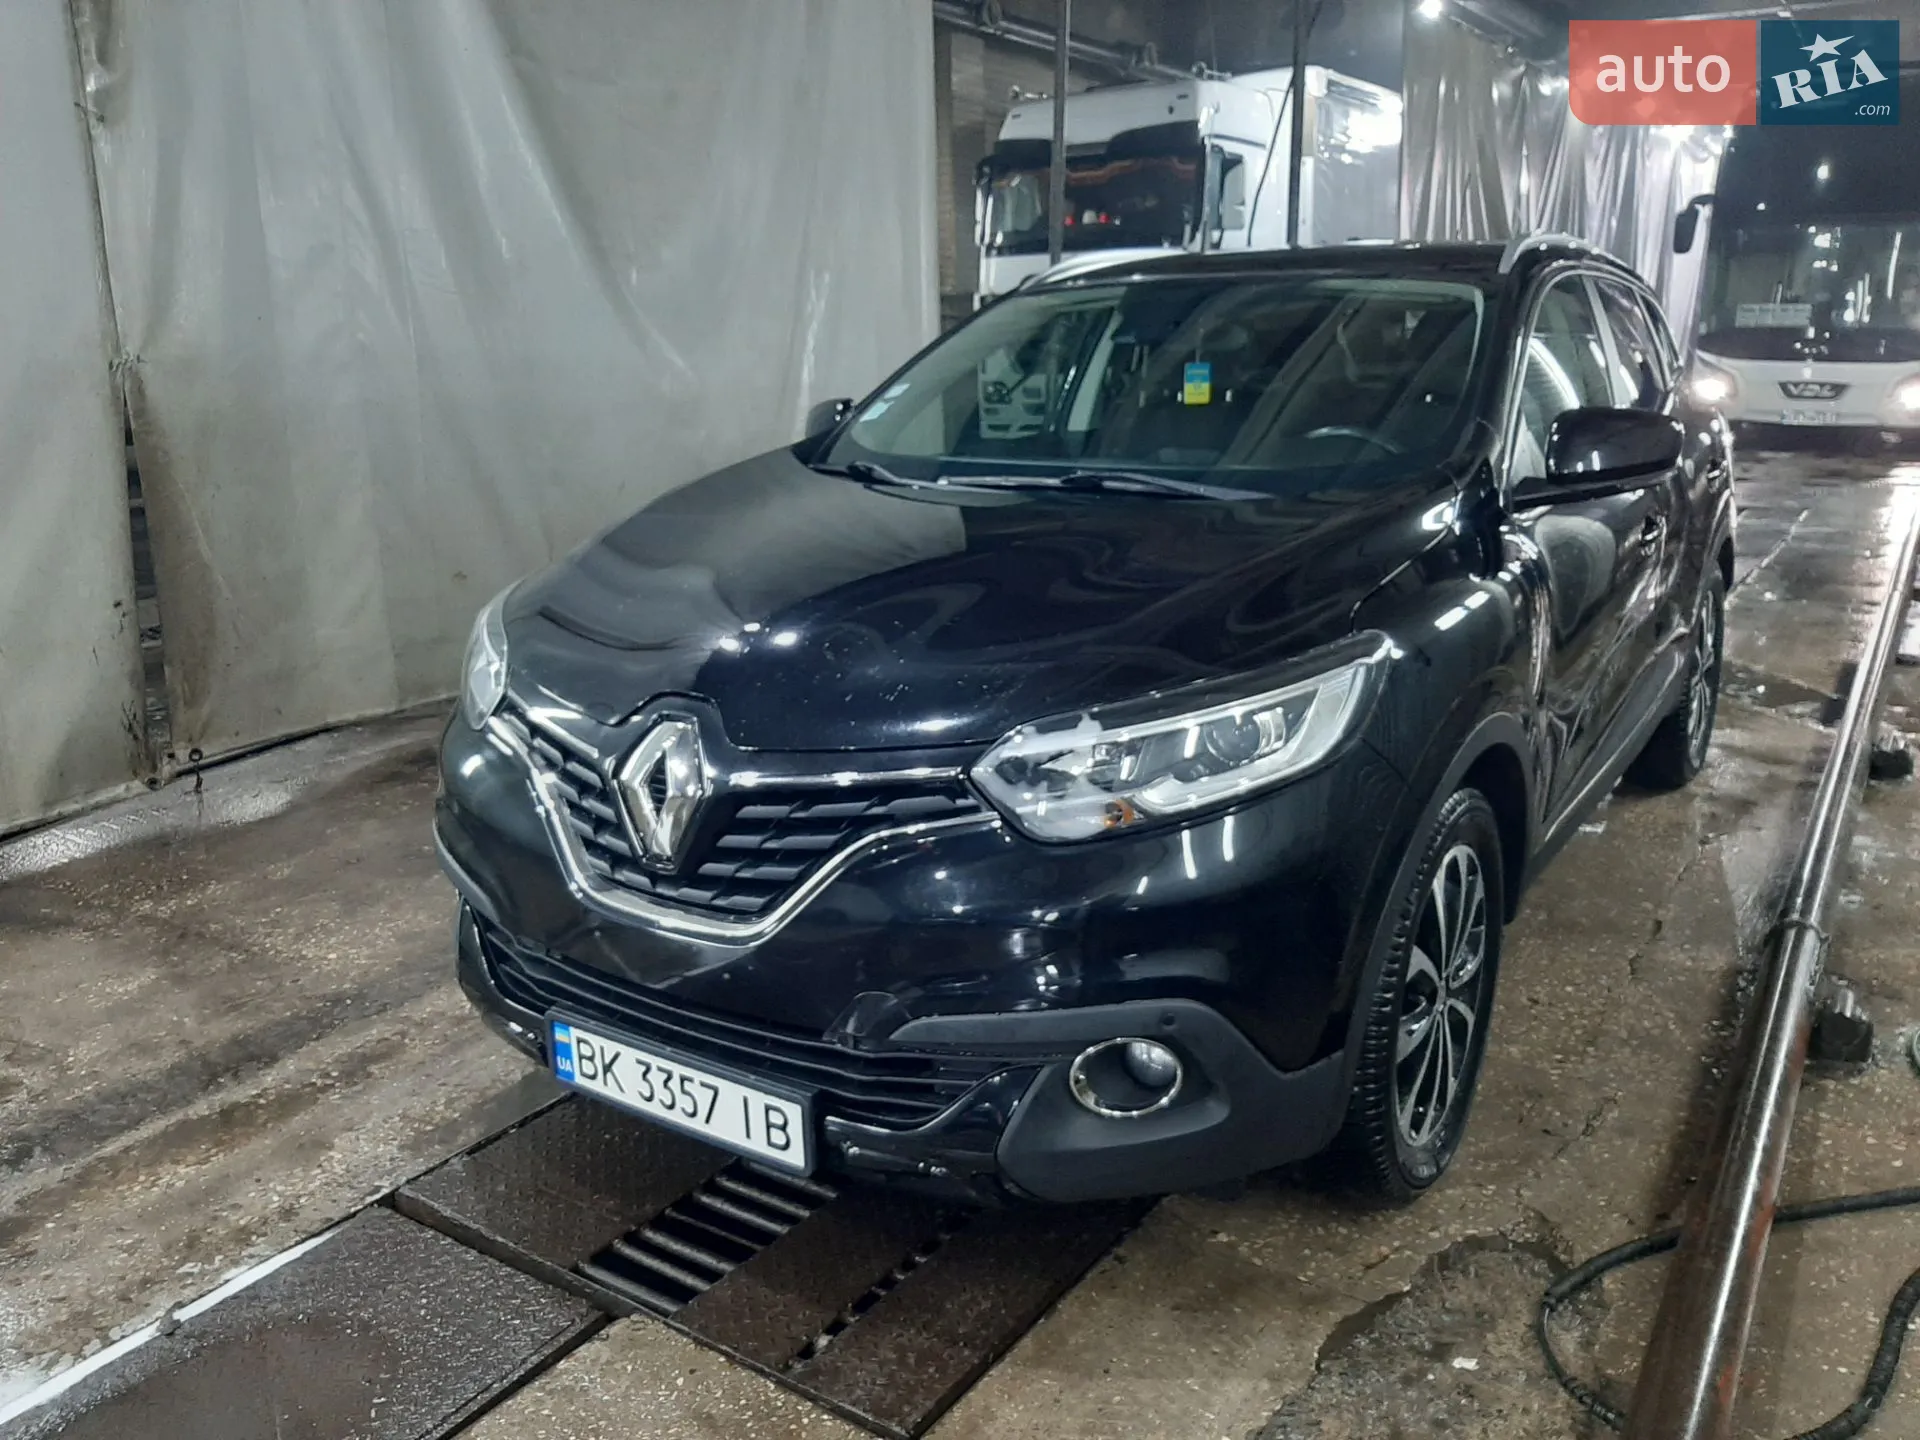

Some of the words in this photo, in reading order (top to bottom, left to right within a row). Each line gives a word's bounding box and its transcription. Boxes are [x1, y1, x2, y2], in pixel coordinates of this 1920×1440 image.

[557, 1055, 573, 1072] UA
[575, 1036, 626, 1094] BK
[634, 1058, 720, 1125] 3357
[742, 1095, 791, 1151] IB
